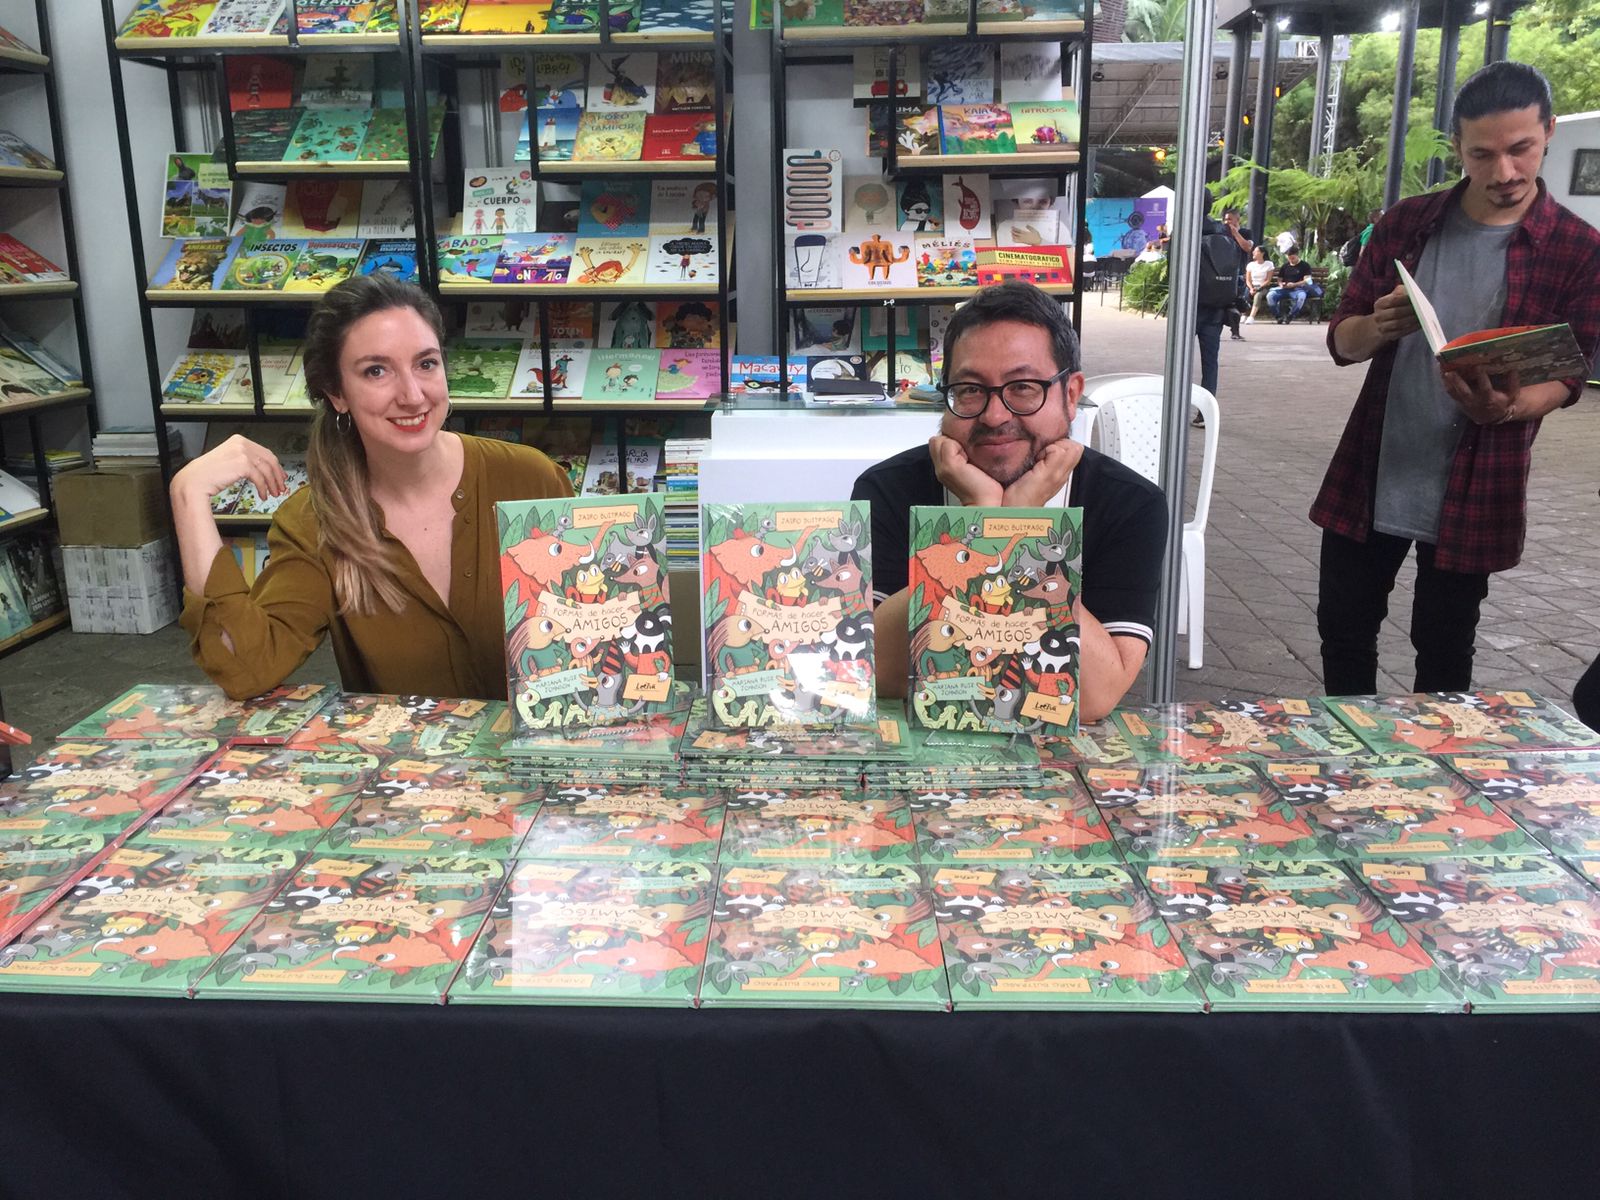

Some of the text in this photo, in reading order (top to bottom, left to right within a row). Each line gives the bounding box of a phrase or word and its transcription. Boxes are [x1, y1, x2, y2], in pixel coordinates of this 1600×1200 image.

[483, 196, 521, 206] CUERPO
[249, 243, 298, 252] INSECTOS
[553, 608, 583, 618] FORMAS
[601, 607, 624, 615] hacer
[753, 608, 783, 619] FORMAS
[801, 610, 824, 618] hacer
[573, 613, 628, 631] AMIGOS
[772, 617, 829, 633] AMIGOS
[956, 614, 1028, 628] FORMAS de hacer
[974, 627, 1032, 642] AMIGOS
[103, 894, 181, 905] AMIGOS
[325, 903, 405, 914] AMIGOS
[770, 909, 848, 920] AMIGOS
[995, 910, 1072, 921] AMIGOS
[1223, 909, 1300, 920] AMIGOS
